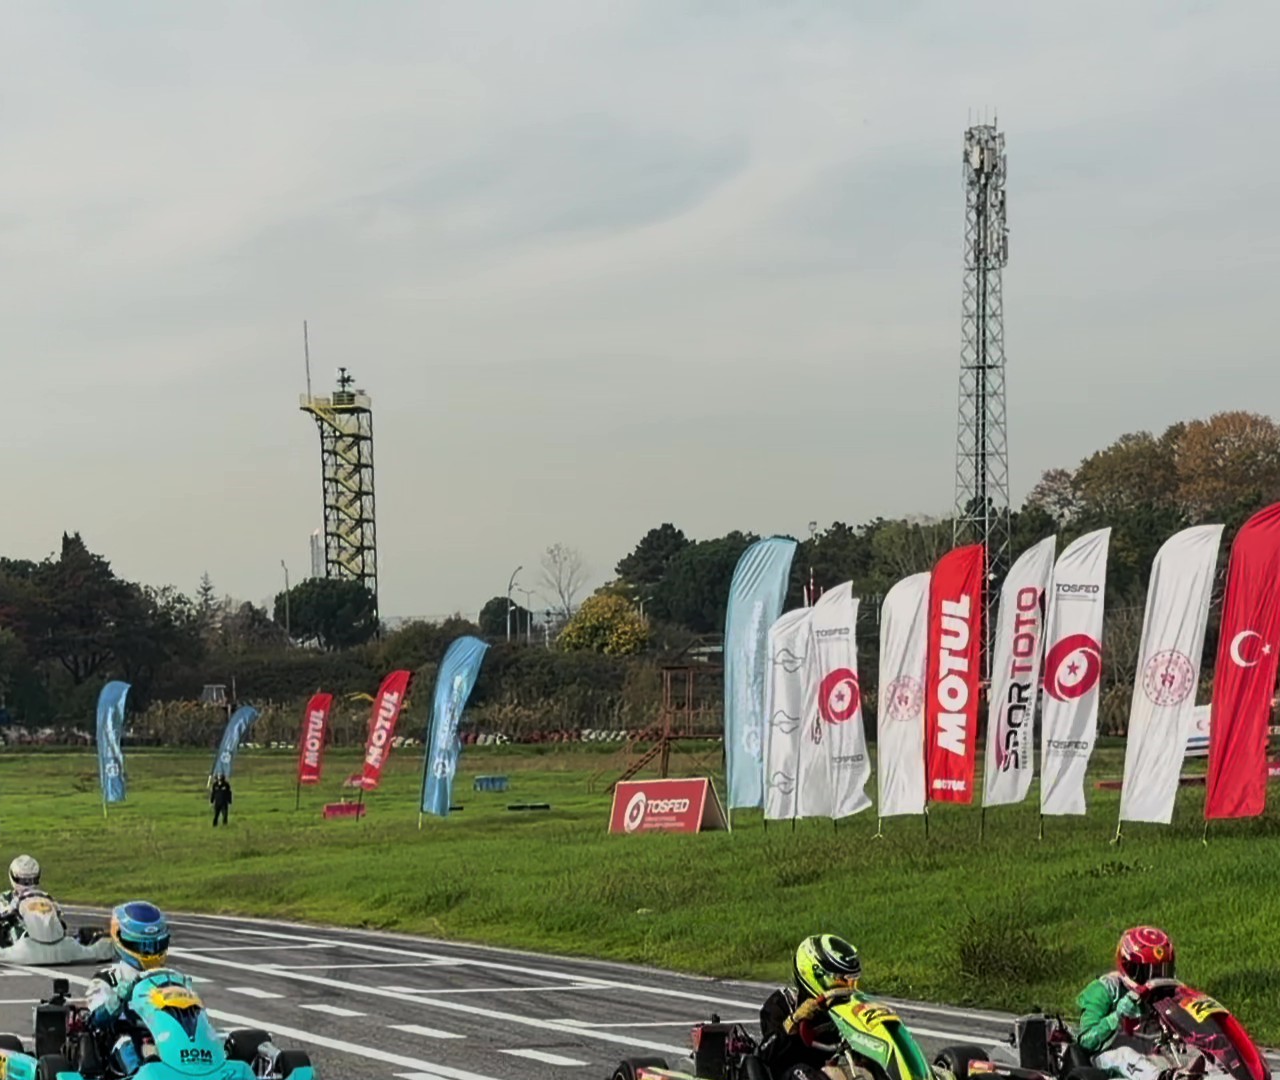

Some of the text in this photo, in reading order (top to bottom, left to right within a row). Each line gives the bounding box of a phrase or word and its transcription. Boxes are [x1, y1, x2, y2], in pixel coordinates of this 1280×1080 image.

[1056, 583, 1099, 593] TOSFED
[937, 594, 970, 756] MOTUL
[305, 709, 324, 768] MOTUL
[366, 691, 399, 769] MOTUL
[1047, 740, 1088, 750] TOSFED
[647, 799, 689, 813] TOSFED
